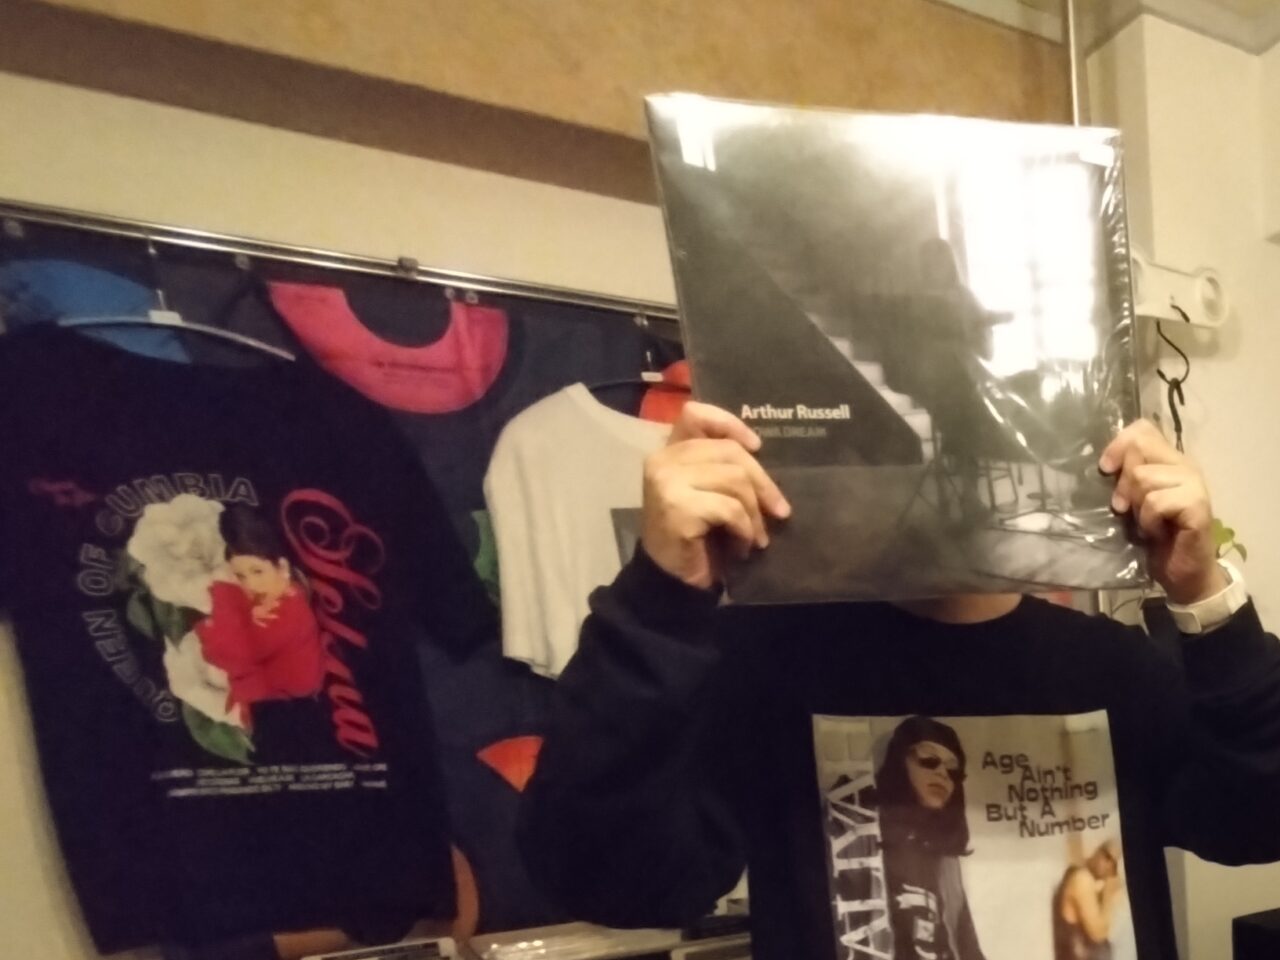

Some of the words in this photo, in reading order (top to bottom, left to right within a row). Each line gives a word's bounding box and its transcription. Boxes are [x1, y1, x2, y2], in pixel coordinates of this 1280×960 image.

[741, 404, 794, 419] Arthur
[796, 404, 851, 419] Russell
[77, 542, 116, 597] OF
[981, 751, 1030, 774] Age
[1021, 764, 1072, 784] Ain't
[1007, 781, 1098, 803] Nothing
[985, 802, 1028, 822] But
[1041, 797, 1057, 819] A
[1019, 813, 1110, 838] Number
